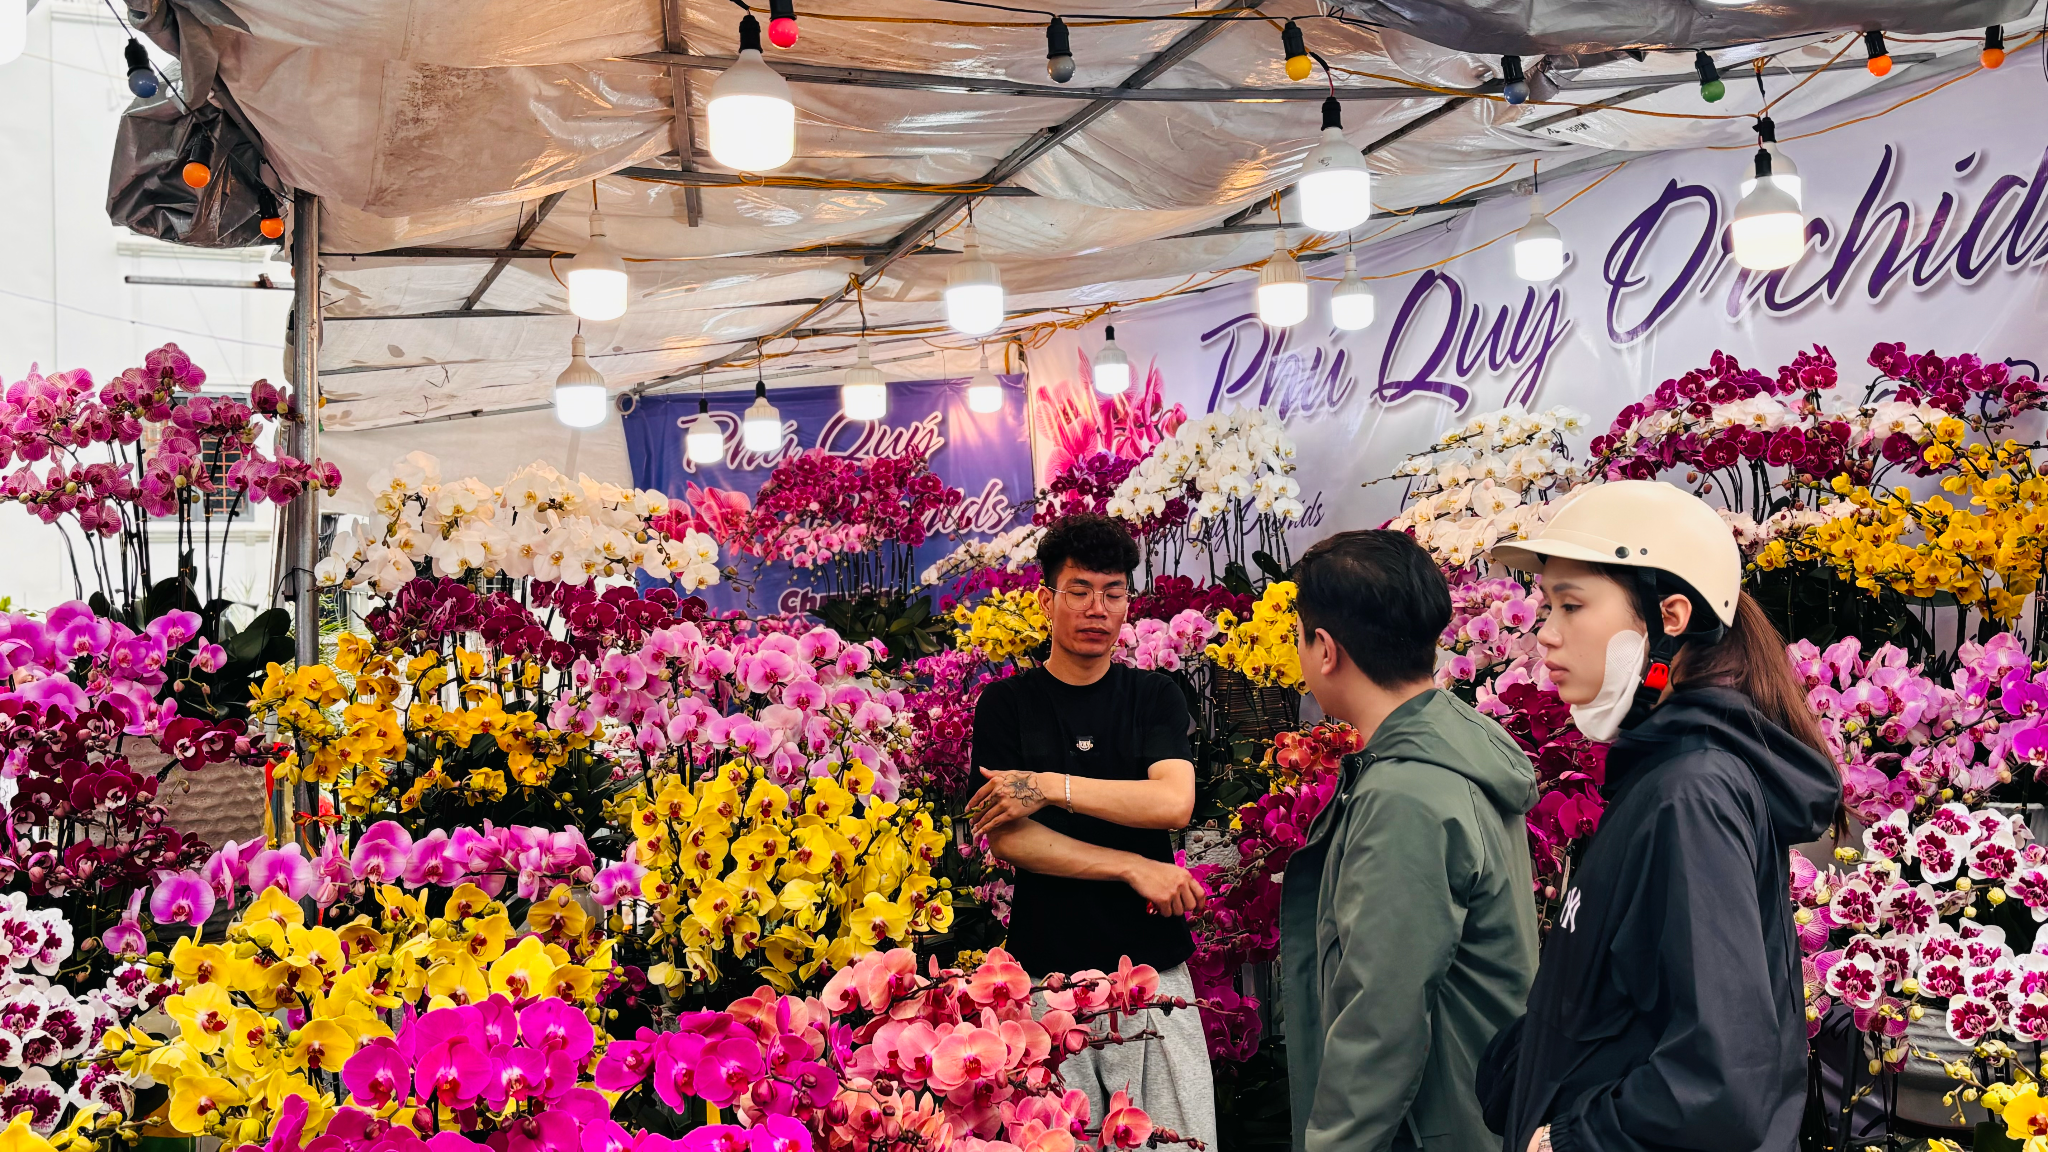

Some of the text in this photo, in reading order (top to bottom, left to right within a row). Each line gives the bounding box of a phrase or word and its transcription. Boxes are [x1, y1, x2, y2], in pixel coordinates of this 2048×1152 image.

[1200, 140, 2048, 420] Phú Quý Orchid
